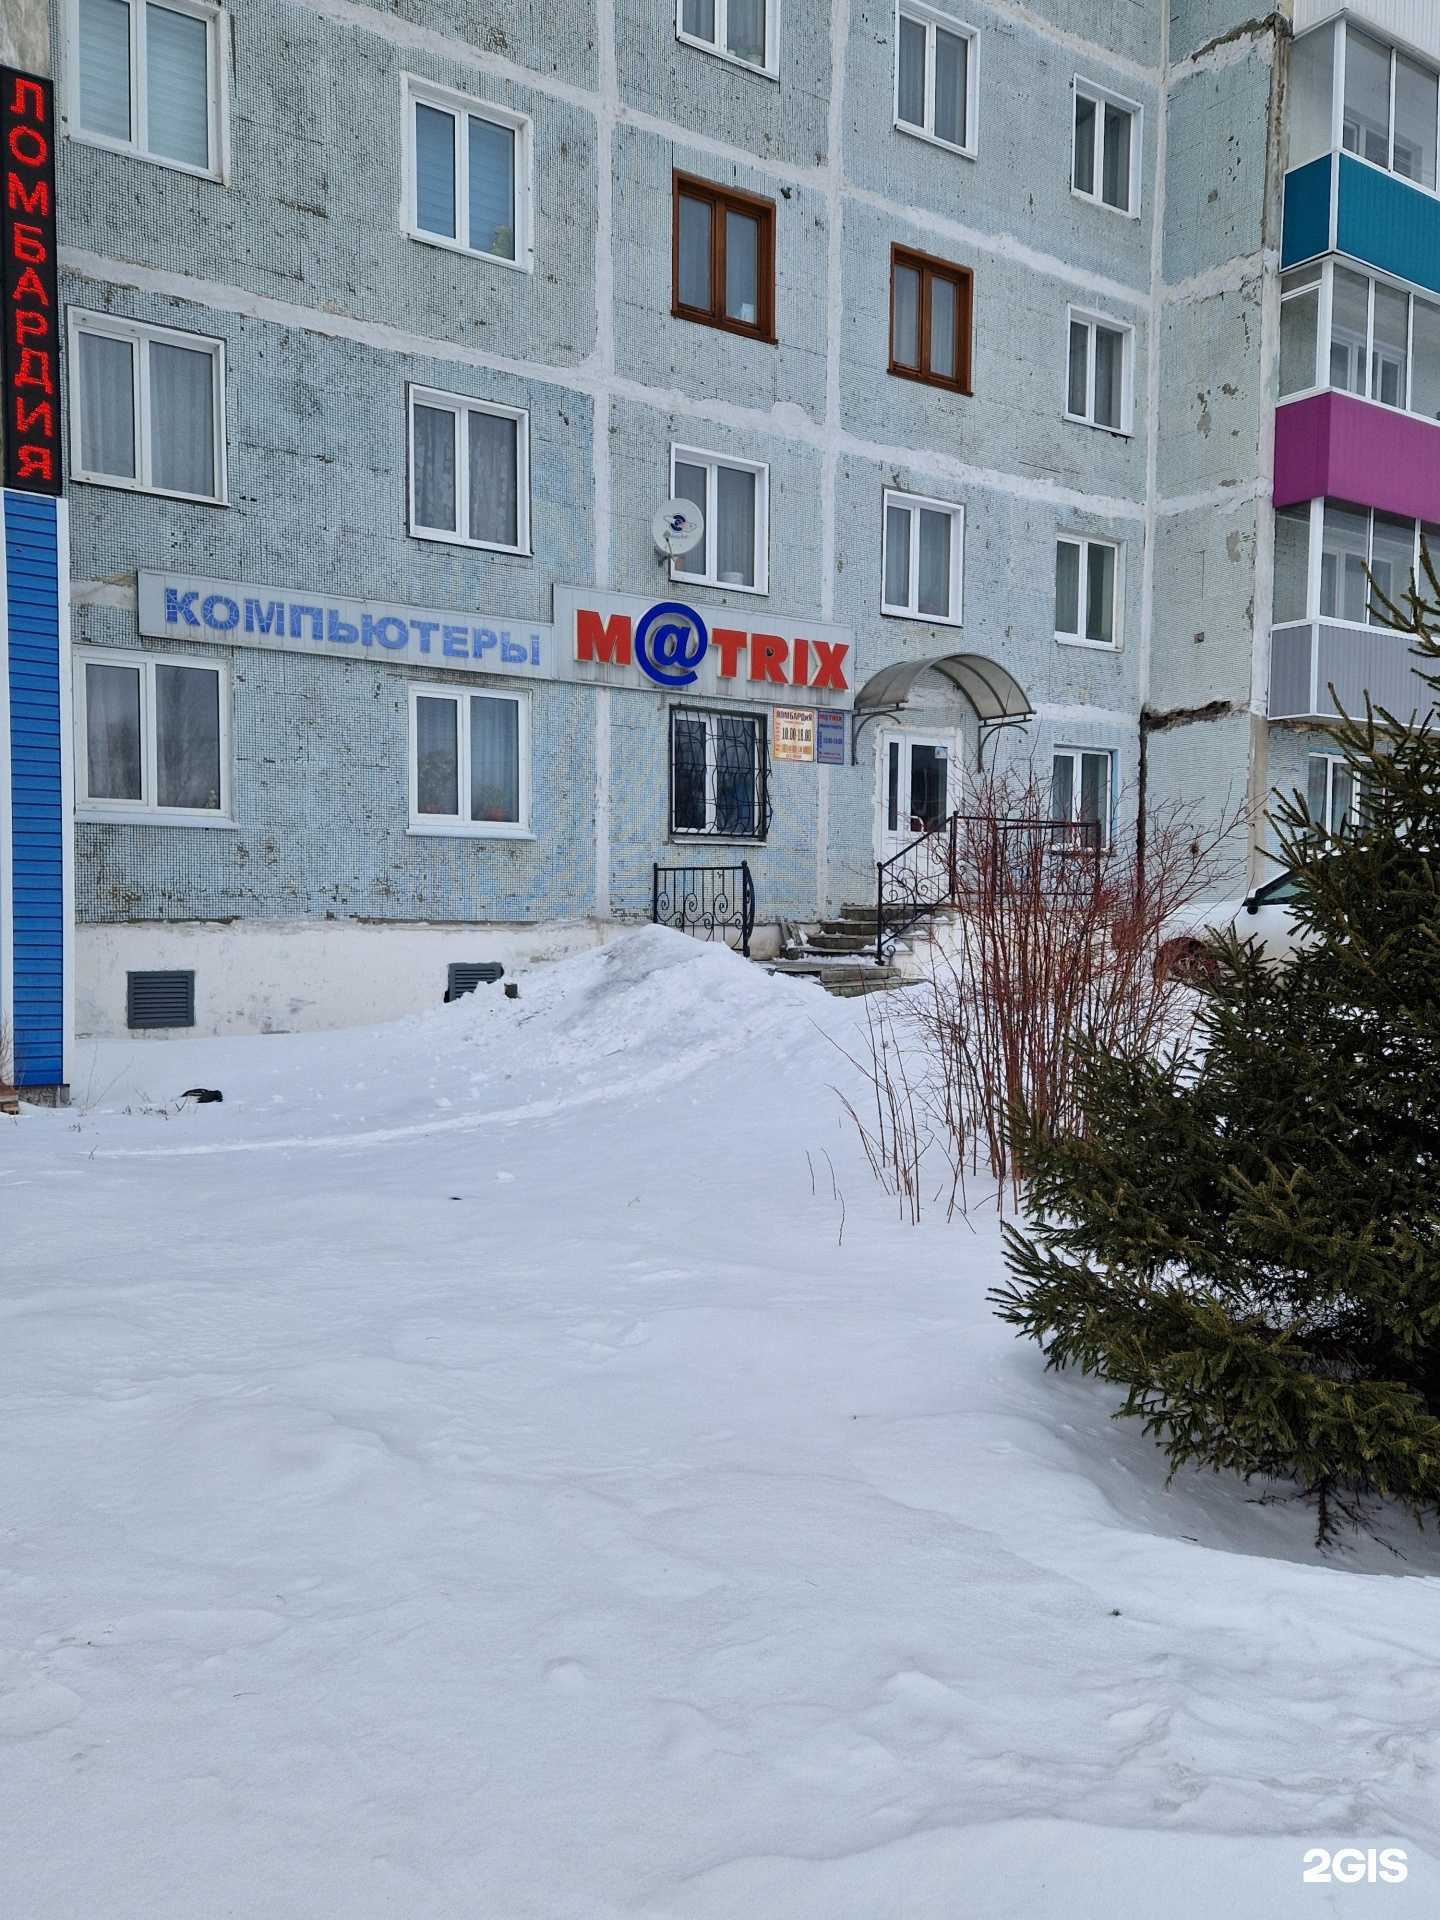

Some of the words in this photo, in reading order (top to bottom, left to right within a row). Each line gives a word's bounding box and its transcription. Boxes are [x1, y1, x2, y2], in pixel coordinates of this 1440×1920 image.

[7, 78, 54, 480] ЛОМБАРДИЯ
[164, 587, 541, 666] КОМПЬЮТЕРЫ
[576, 601, 850, 690] M@TRIX
